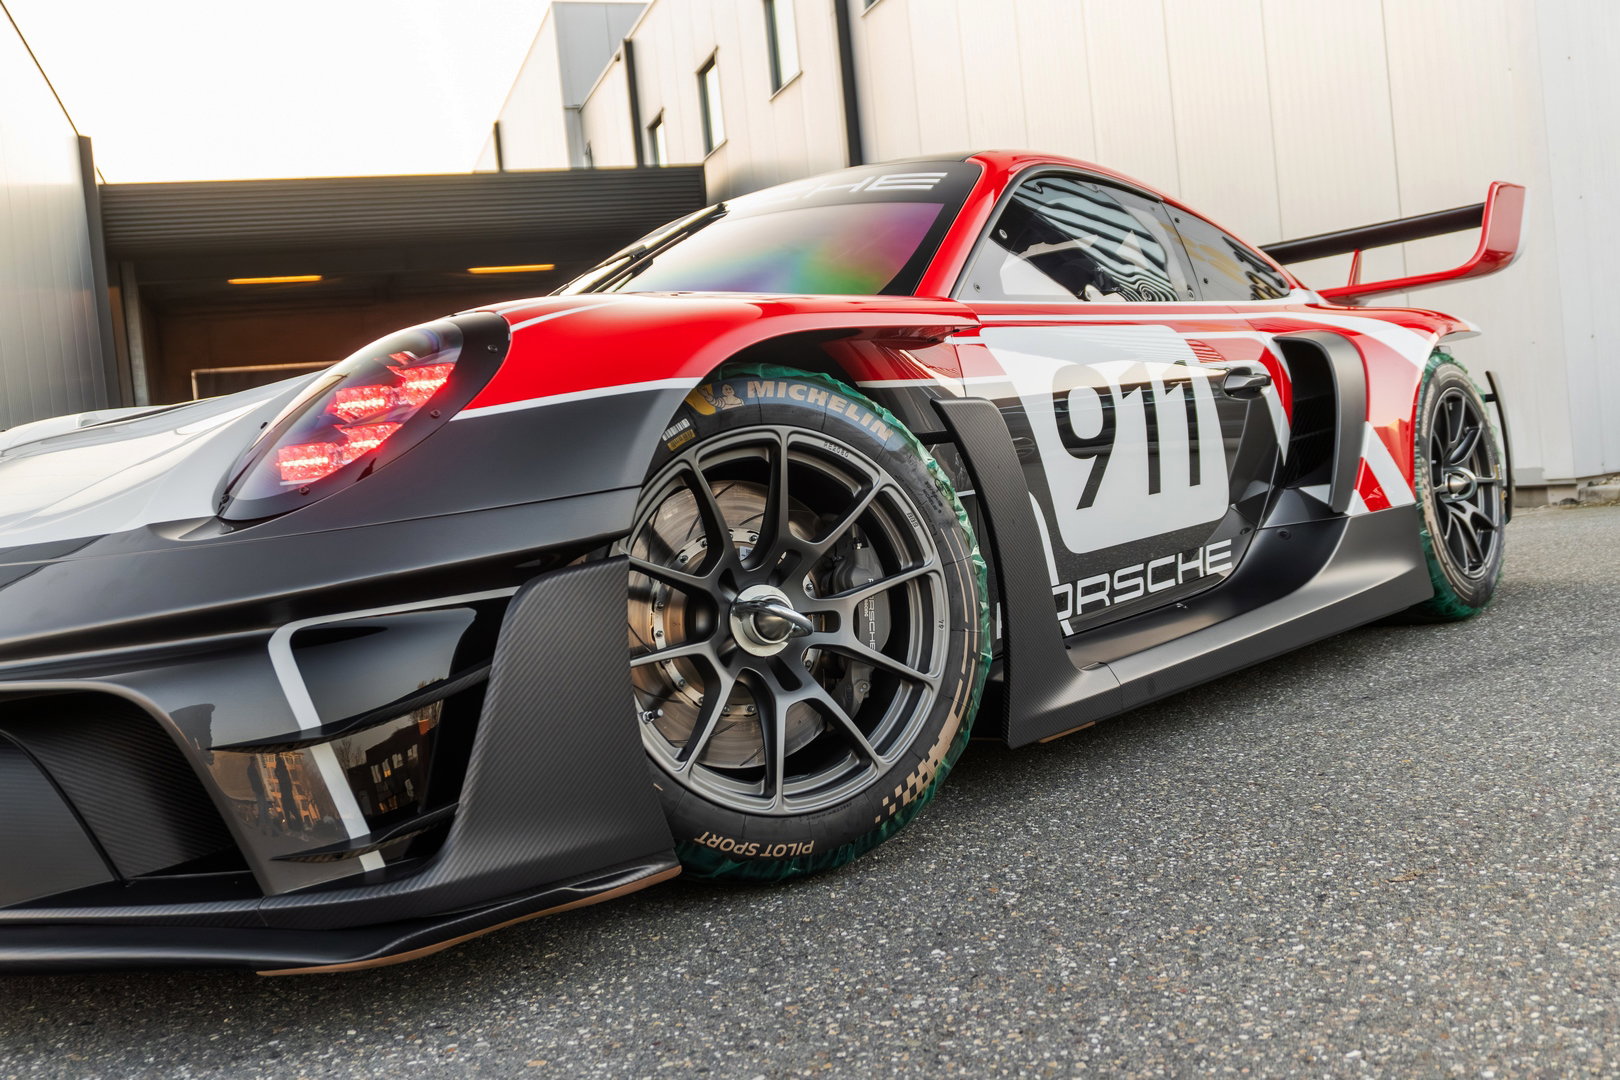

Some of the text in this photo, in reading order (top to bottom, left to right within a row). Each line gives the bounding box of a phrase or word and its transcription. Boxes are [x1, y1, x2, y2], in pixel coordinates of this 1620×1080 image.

[747, 380, 894, 441] MICHELIN
[1052, 361, 1202, 510] 911
[1051, 539, 1233, 621] ORSCHE
[694, 831, 815, 857] PILOT SPORT
